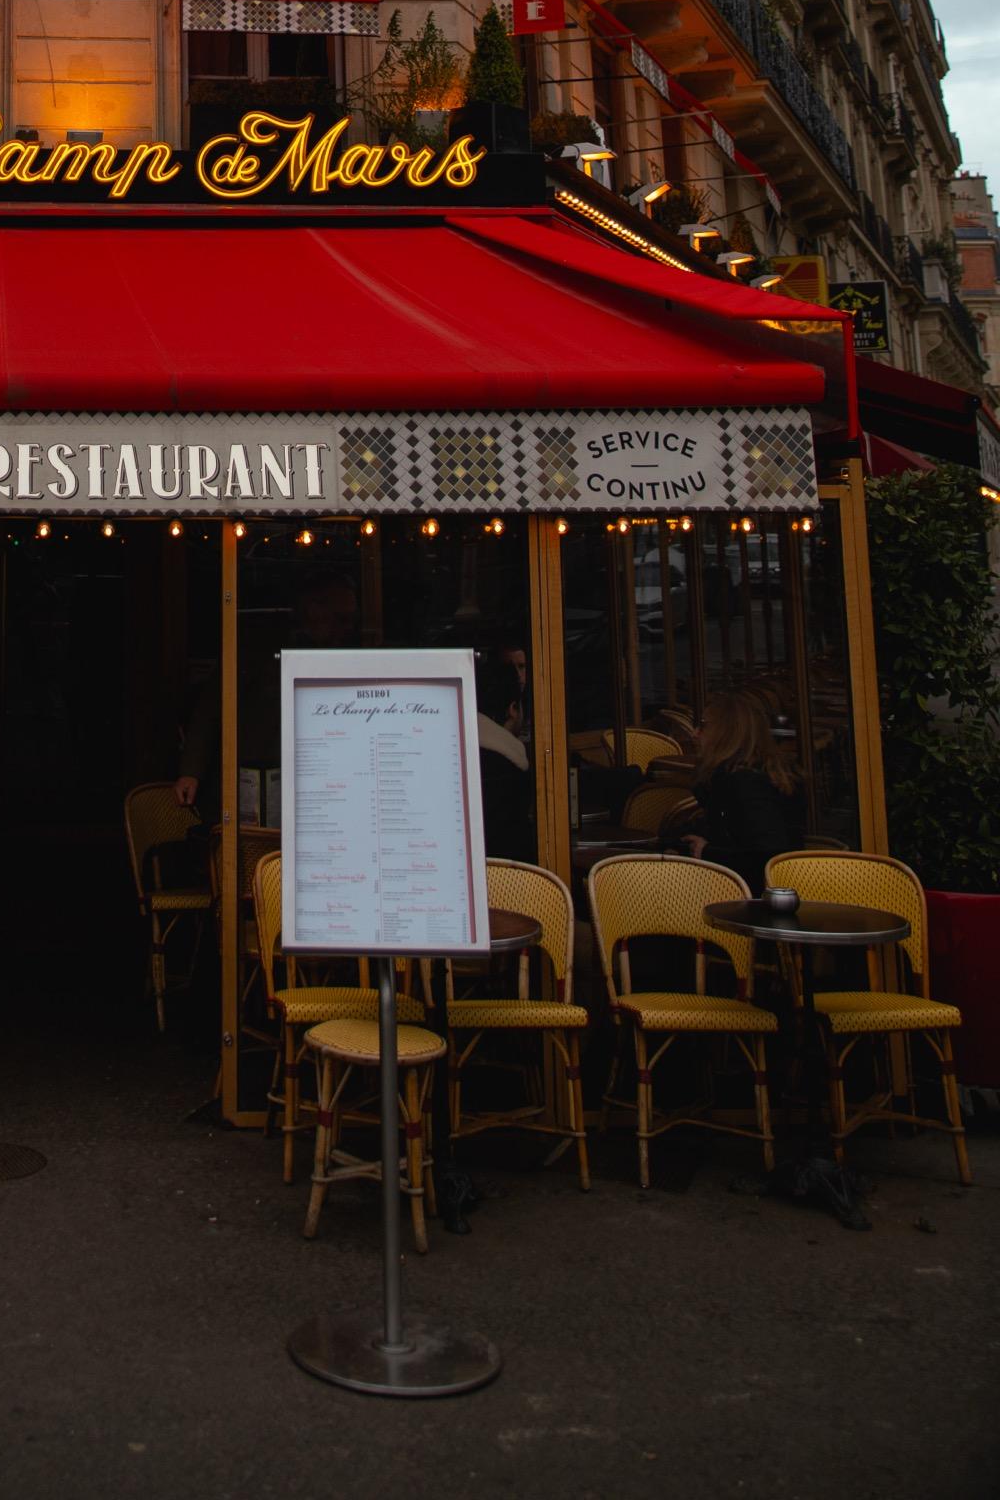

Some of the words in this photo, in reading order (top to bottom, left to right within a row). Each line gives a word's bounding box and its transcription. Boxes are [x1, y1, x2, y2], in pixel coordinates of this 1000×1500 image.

[196, 109, 488, 198] Mars
[211, 142, 262, 184] de
[586, 430, 697, 459] SERVICE
[586, 470, 706, 501] CONTINU
[356, 689, 391, 699] BISTROT
[312, 703, 330, 716] Le
[333, 700, 380, 723] Champ
[383, 702, 398, 715] de
[399, 702, 440, 715] Mars
